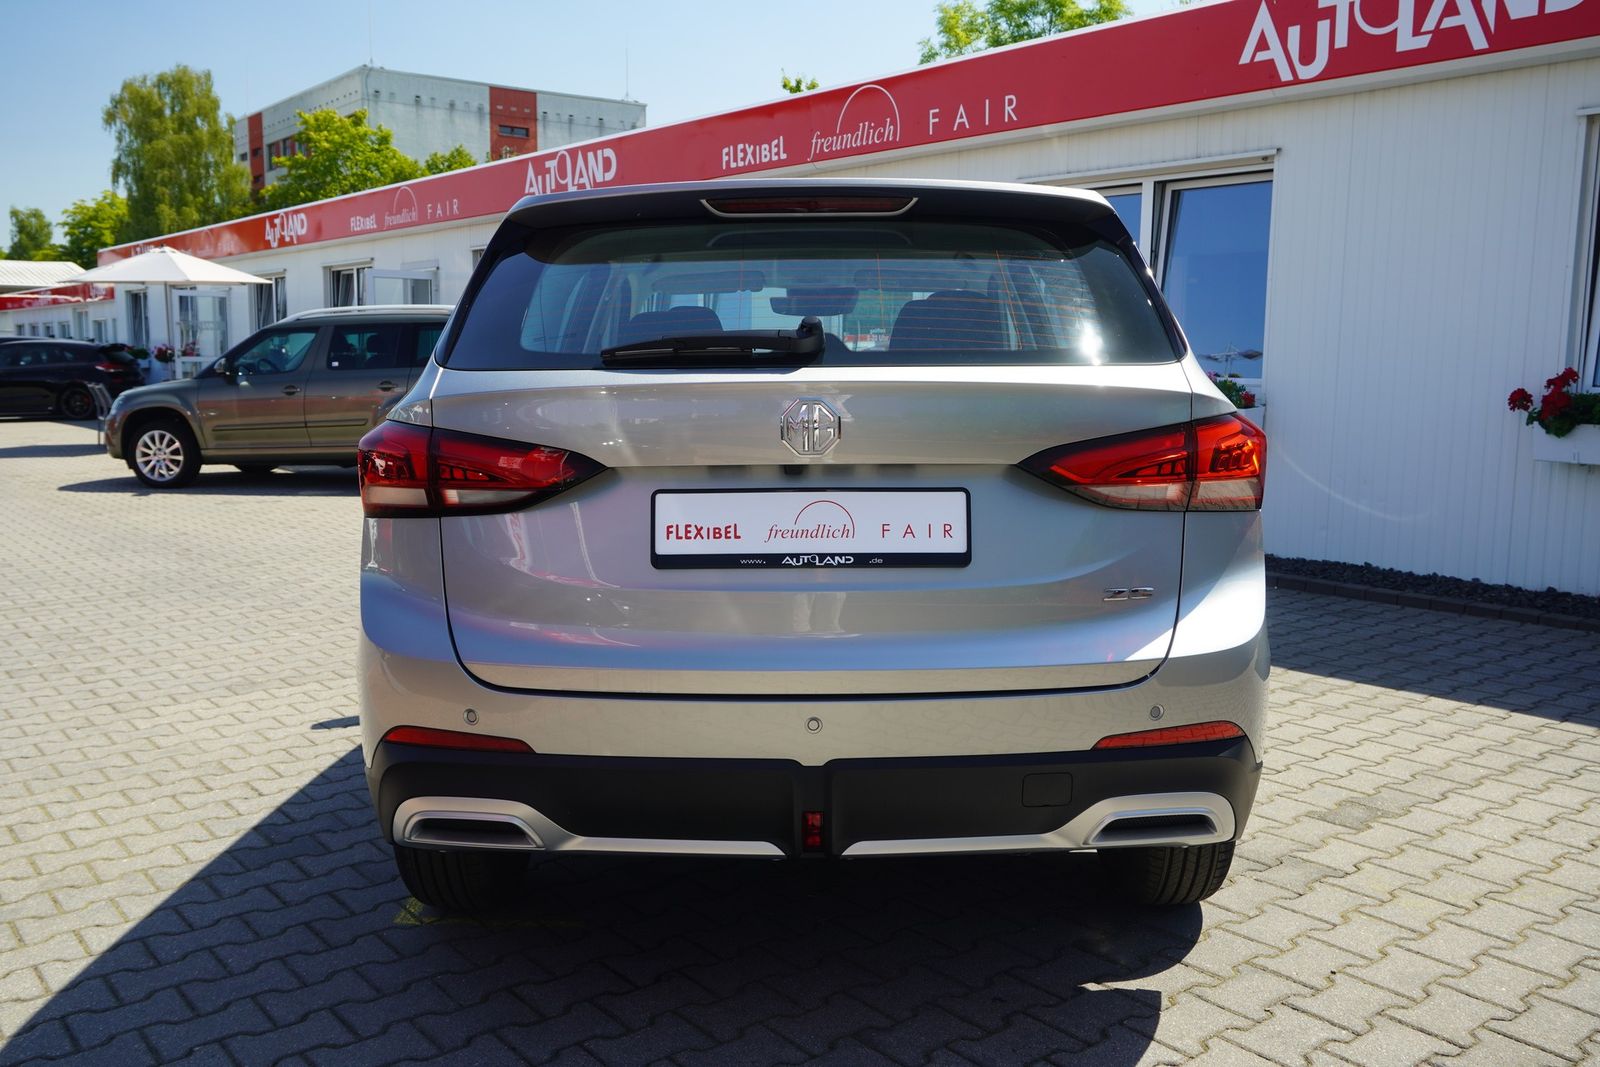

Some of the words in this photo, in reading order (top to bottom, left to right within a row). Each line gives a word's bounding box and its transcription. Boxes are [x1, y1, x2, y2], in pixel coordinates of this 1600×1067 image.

[721, 136, 787, 170] FLEXIBEL
[807, 117, 894, 162] freundlich
[928, 94, 1018, 135] FAIR
[427, 198, 459, 220] FAIR
[784, 402, 837, 454] MG
[665, 523, 742, 541] FLEXIBEL
[764, 523, 851, 543] freundlich
[881, 523, 953, 539] FAIR
[869, 556, 884, 565] .de
